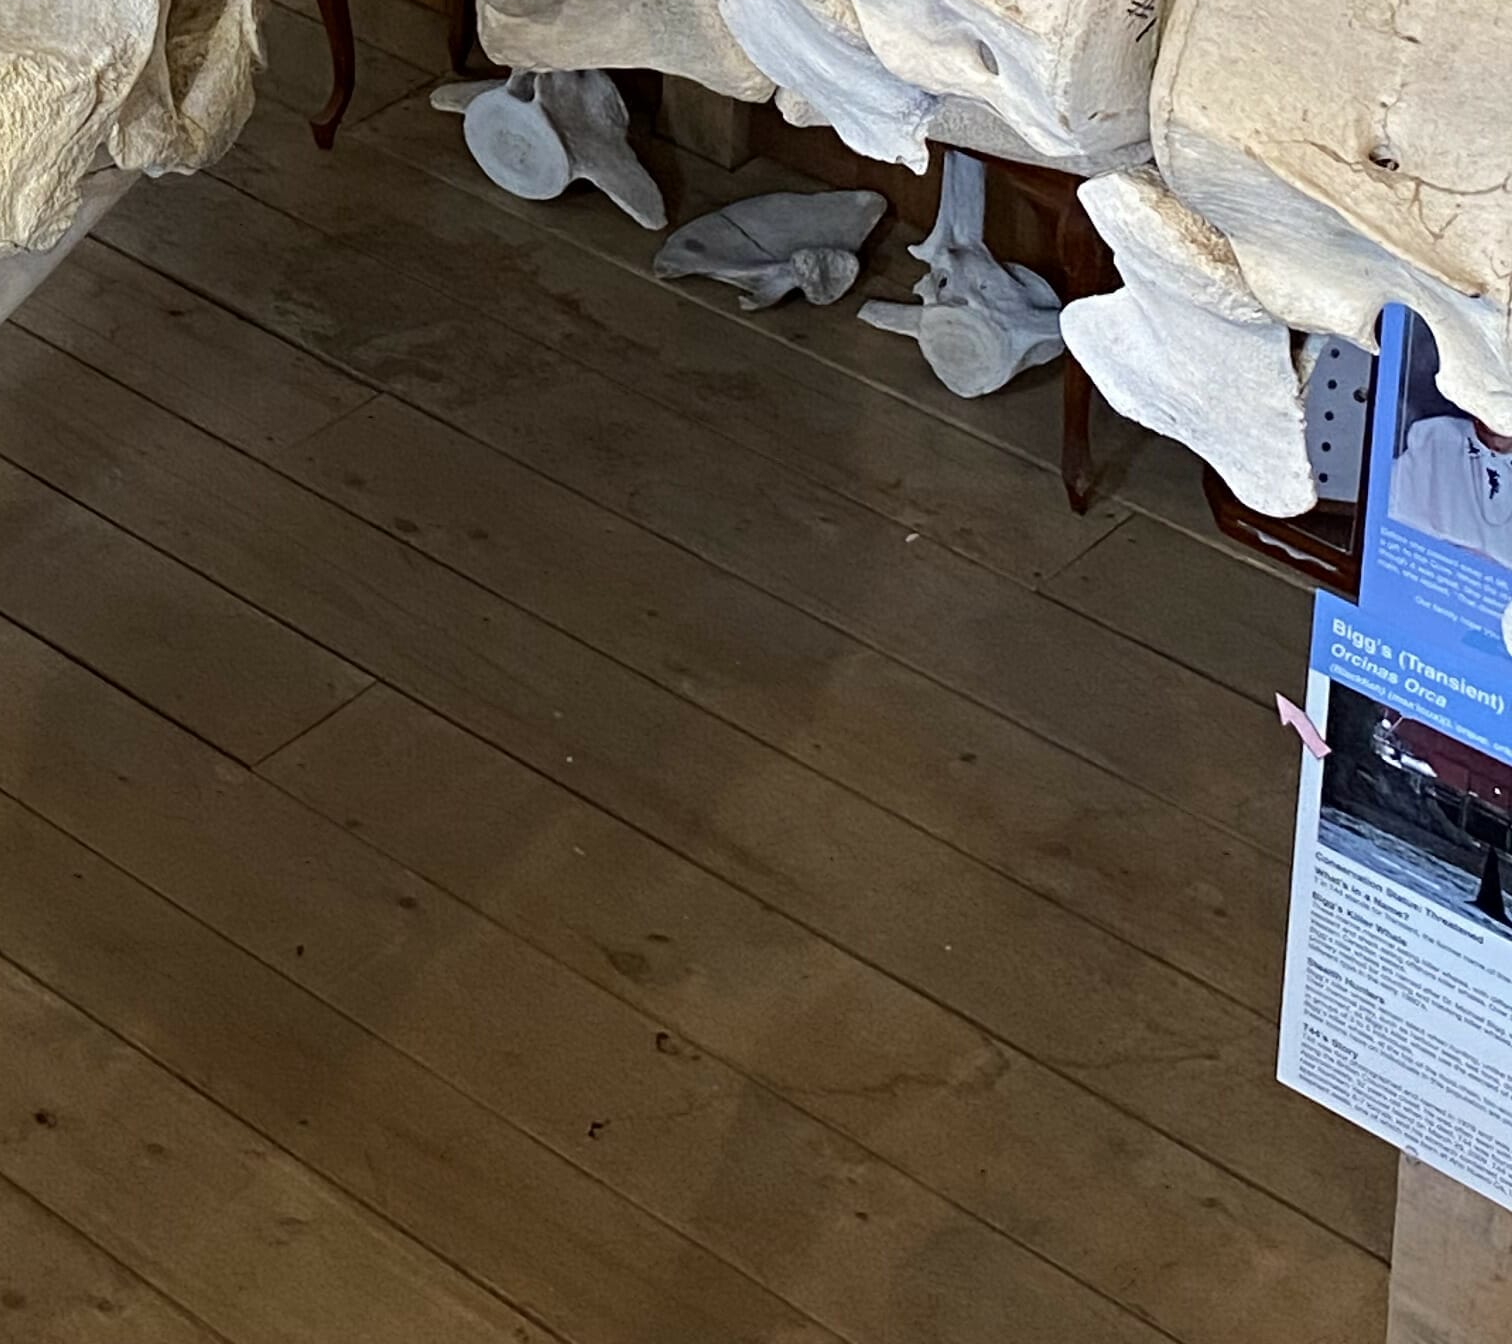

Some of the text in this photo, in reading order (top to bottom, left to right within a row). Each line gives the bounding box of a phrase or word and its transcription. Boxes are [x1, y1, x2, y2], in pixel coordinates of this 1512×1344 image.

[1332, 618, 1392, 659] Bigg's
[1399, 650, 1505, 714] (Transient)
[1405, 676, 1448, 709] Orca
